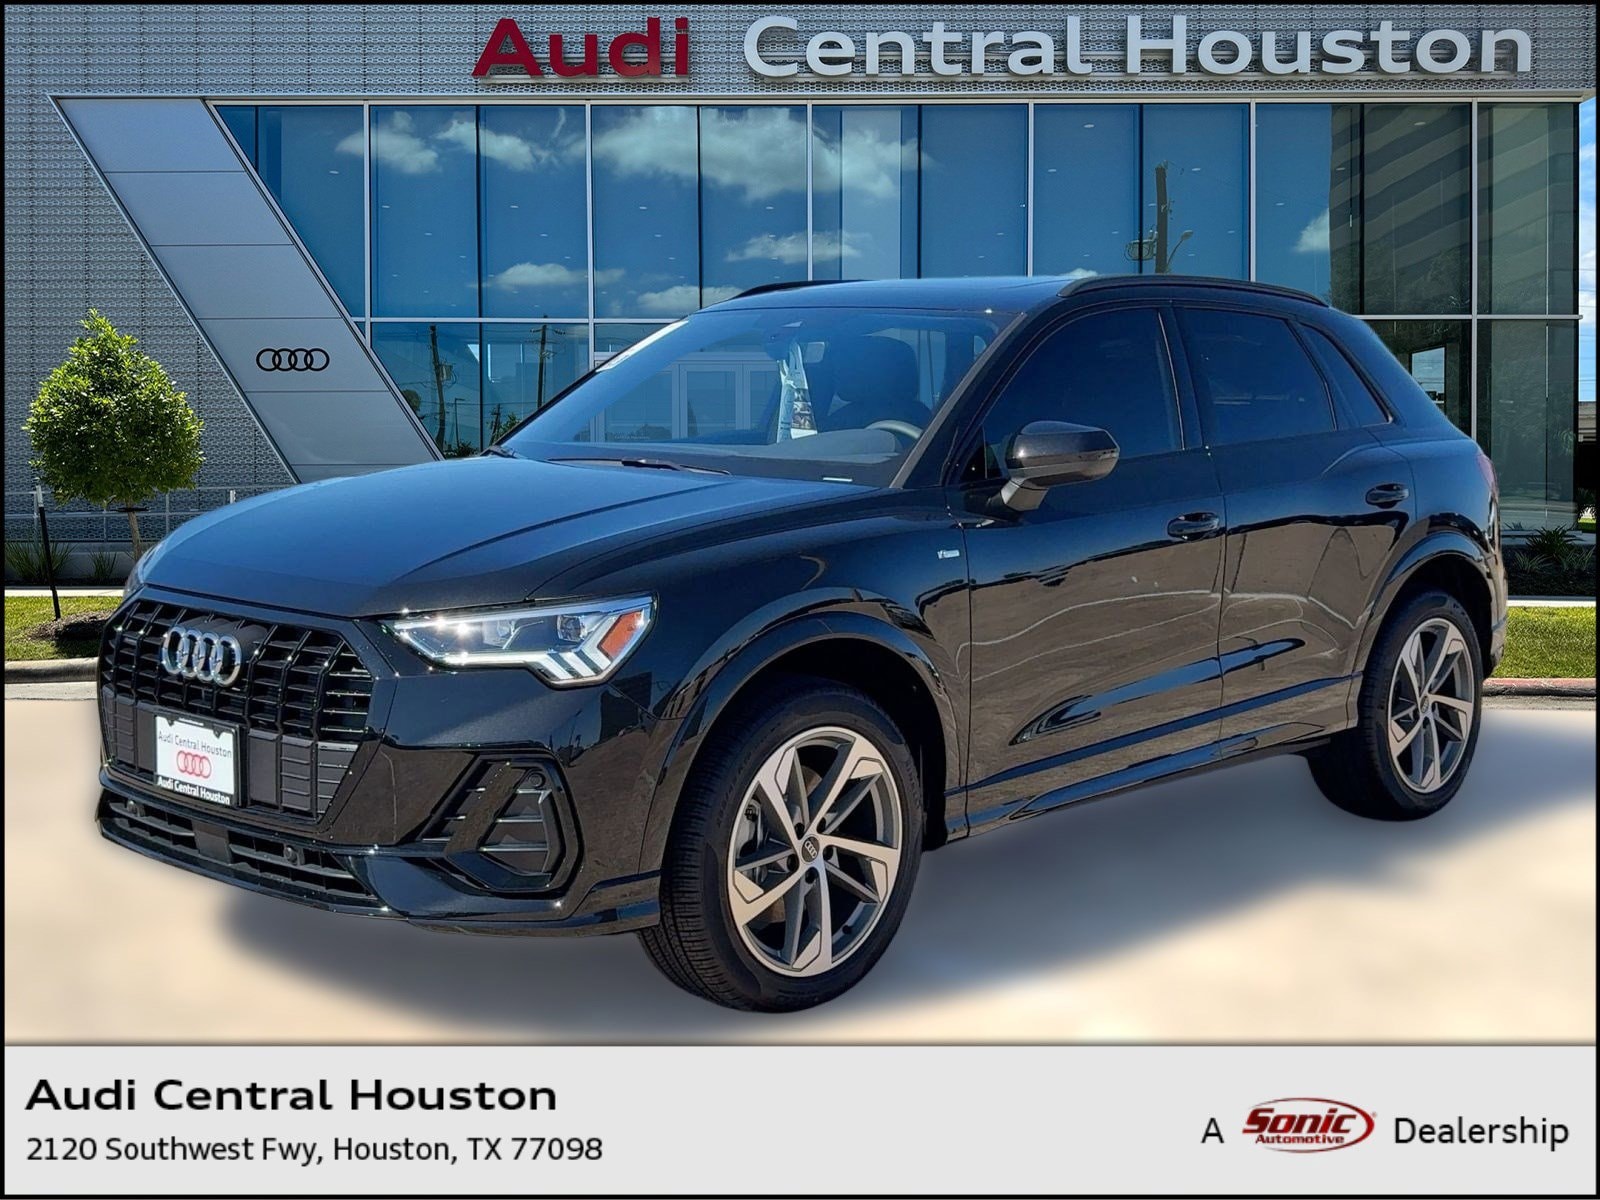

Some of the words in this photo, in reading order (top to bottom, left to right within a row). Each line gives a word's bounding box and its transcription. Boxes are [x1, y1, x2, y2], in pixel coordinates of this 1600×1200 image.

[473, 17, 691, 78] Audi
[743, 15, 1092, 77] Central
[1125, 14, 1533, 76] Houston
[158, 730, 173, 743] Audi
[175, 735, 199, 750] Central
[201, 742, 232, 757] Houston
[158, 776, 173, 790] Audi
[175, 780, 199, 797] Central
[200, 787, 230, 805] Houston
